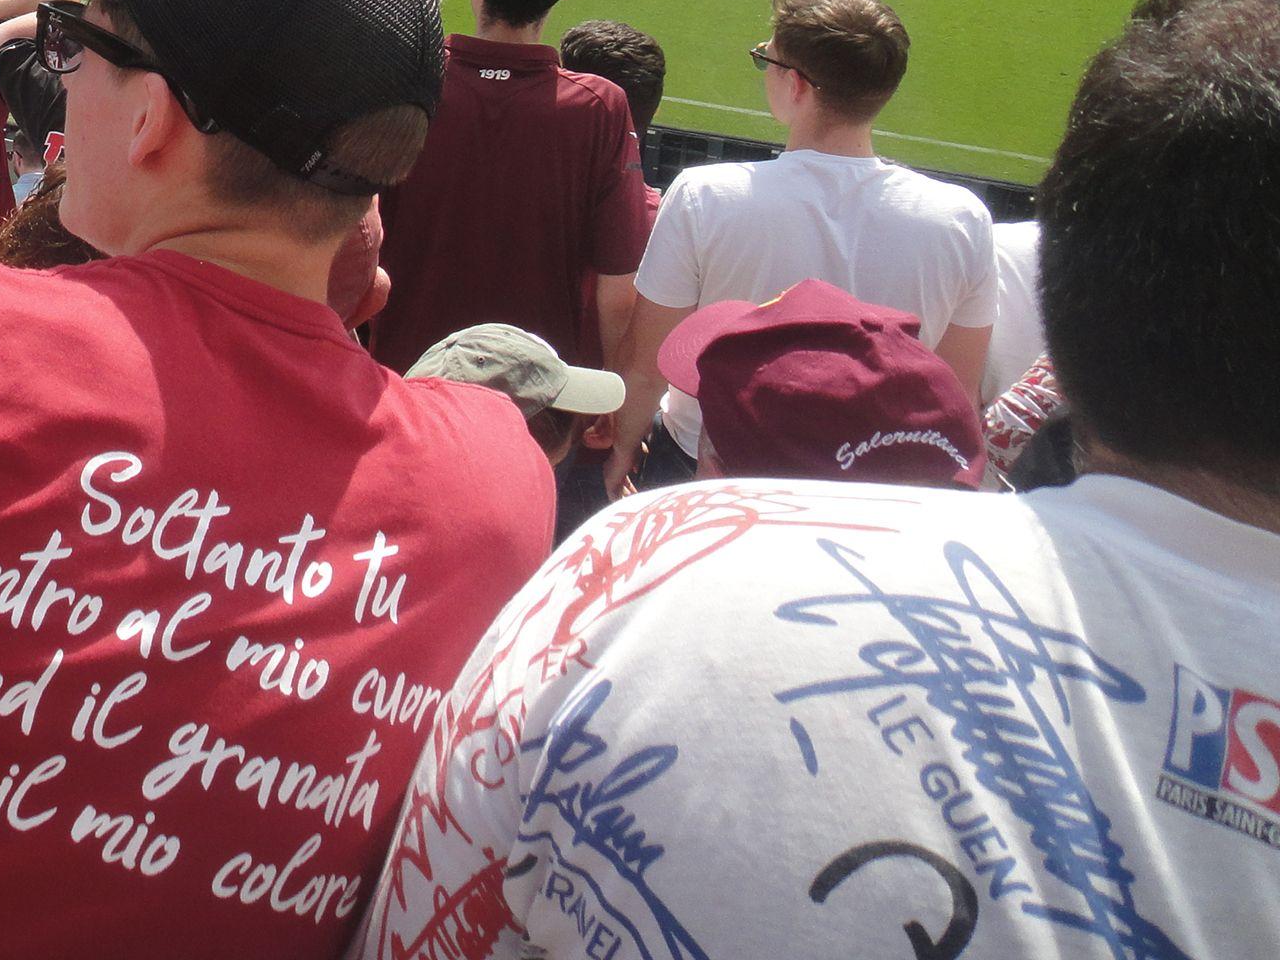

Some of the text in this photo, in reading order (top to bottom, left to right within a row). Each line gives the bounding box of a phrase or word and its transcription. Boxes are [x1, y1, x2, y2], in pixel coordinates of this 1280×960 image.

[478, 68, 511, 81] 1919
[835, 429, 970, 471] Salernitana
[80, 451, 333, 605] Soltanto
[353, 531, 407, 624] tu
[116, 592, 212, 662] al
[226, 635, 329, 700] mio
[352, 668, 442, 734] cuor
[71, 671, 147, 749] il
[142, 722, 381, 830] granata
[866, 694, 1033, 902] LE GUEN
[1158, 775, 1207, 816] PARIS
[1170, 667, 1280, 804] PS
[71, 804, 181, 876] mio
[212, 833, 361, 925] colore
